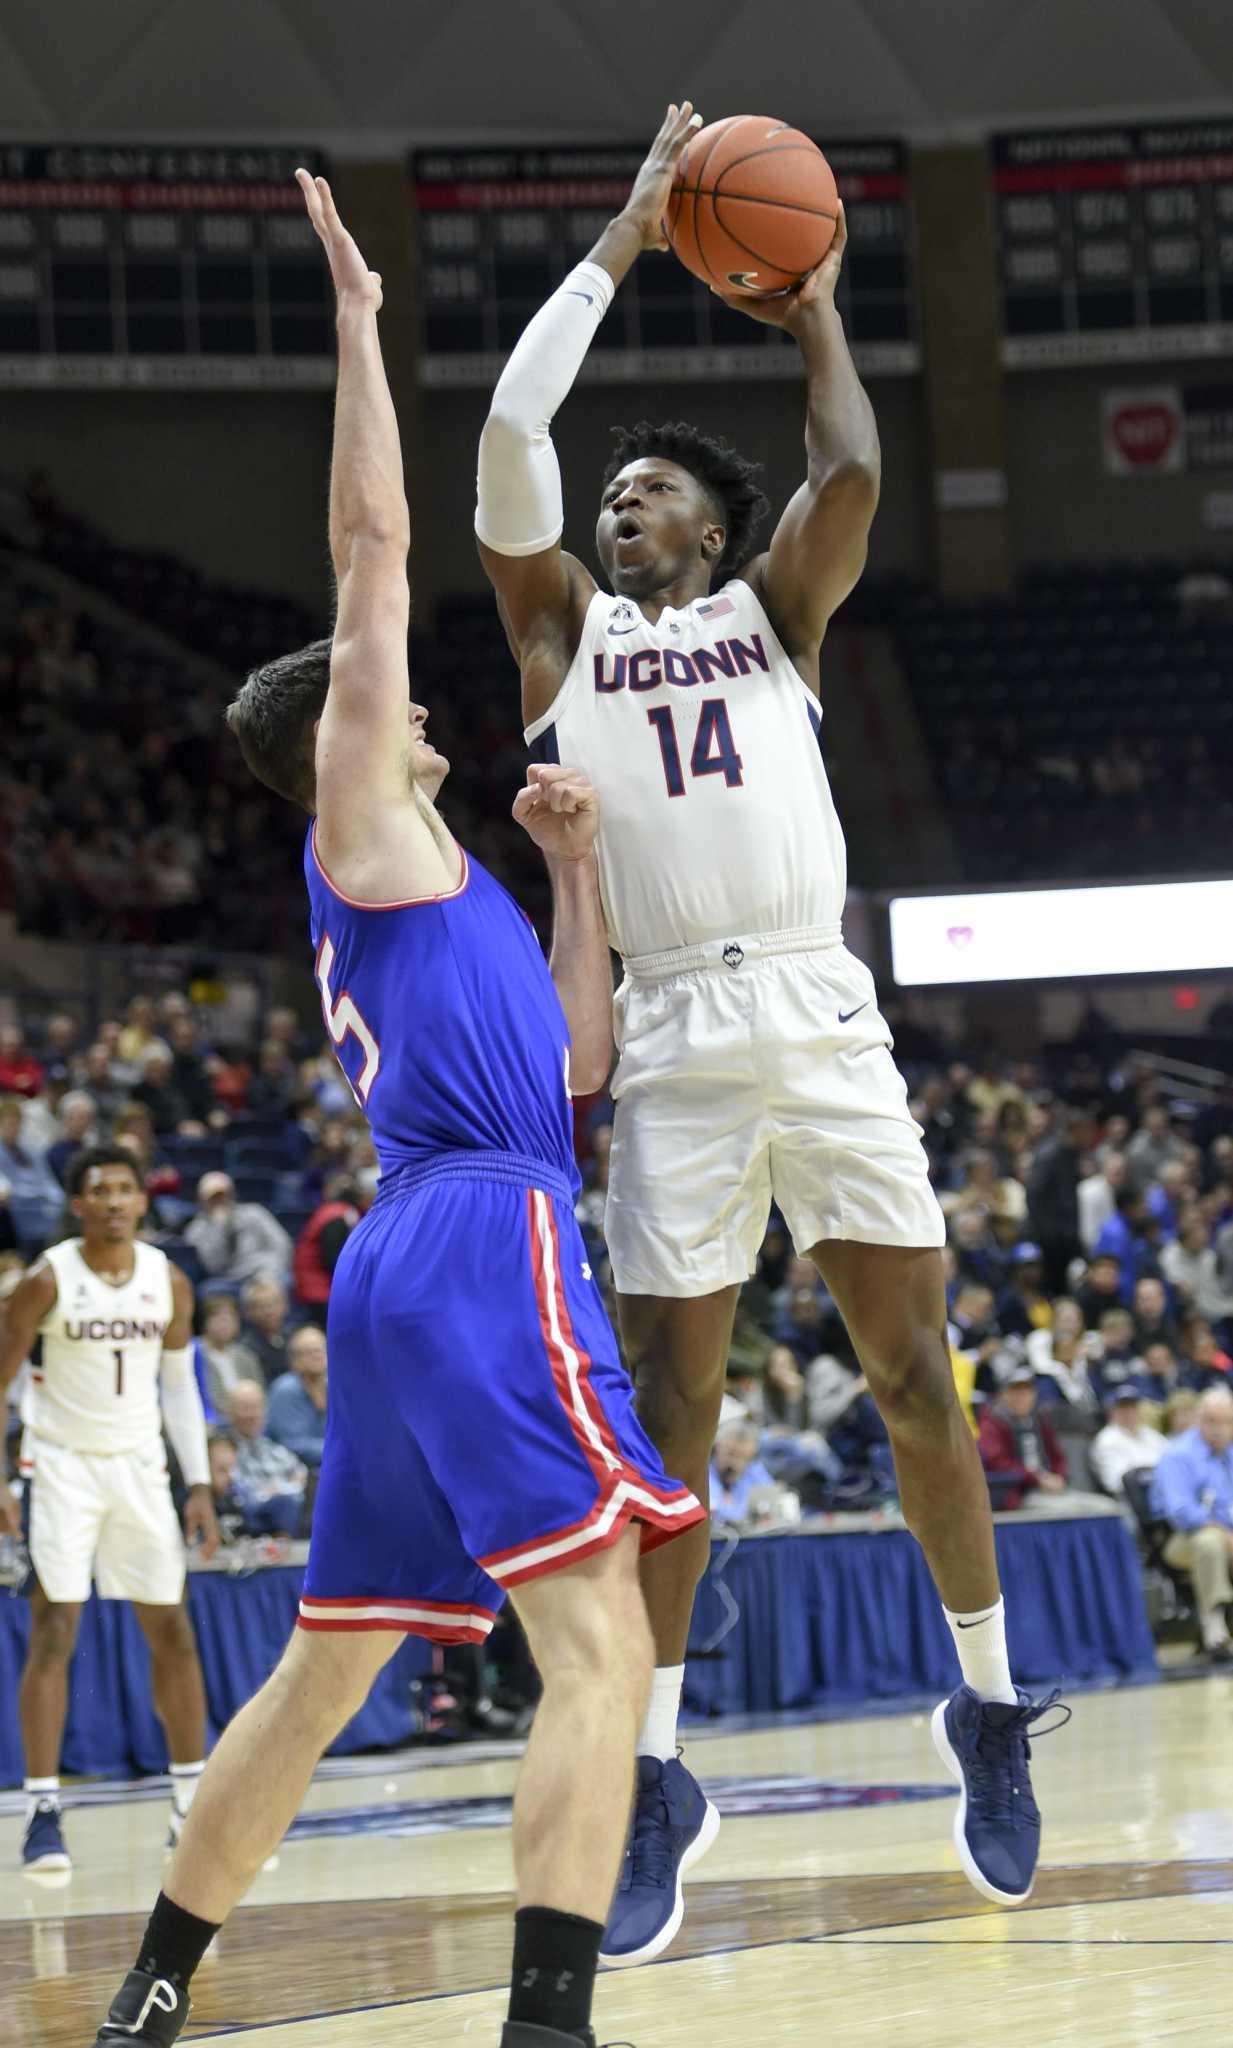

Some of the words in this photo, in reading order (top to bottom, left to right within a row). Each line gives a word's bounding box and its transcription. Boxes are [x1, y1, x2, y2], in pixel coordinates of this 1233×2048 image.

[594, 634, 770, 693] UCONN
[647, 698, 743, 798] 14
[66, 1319, 165, 1340] UCONN
[112, 1348, 123, 1396] 1
